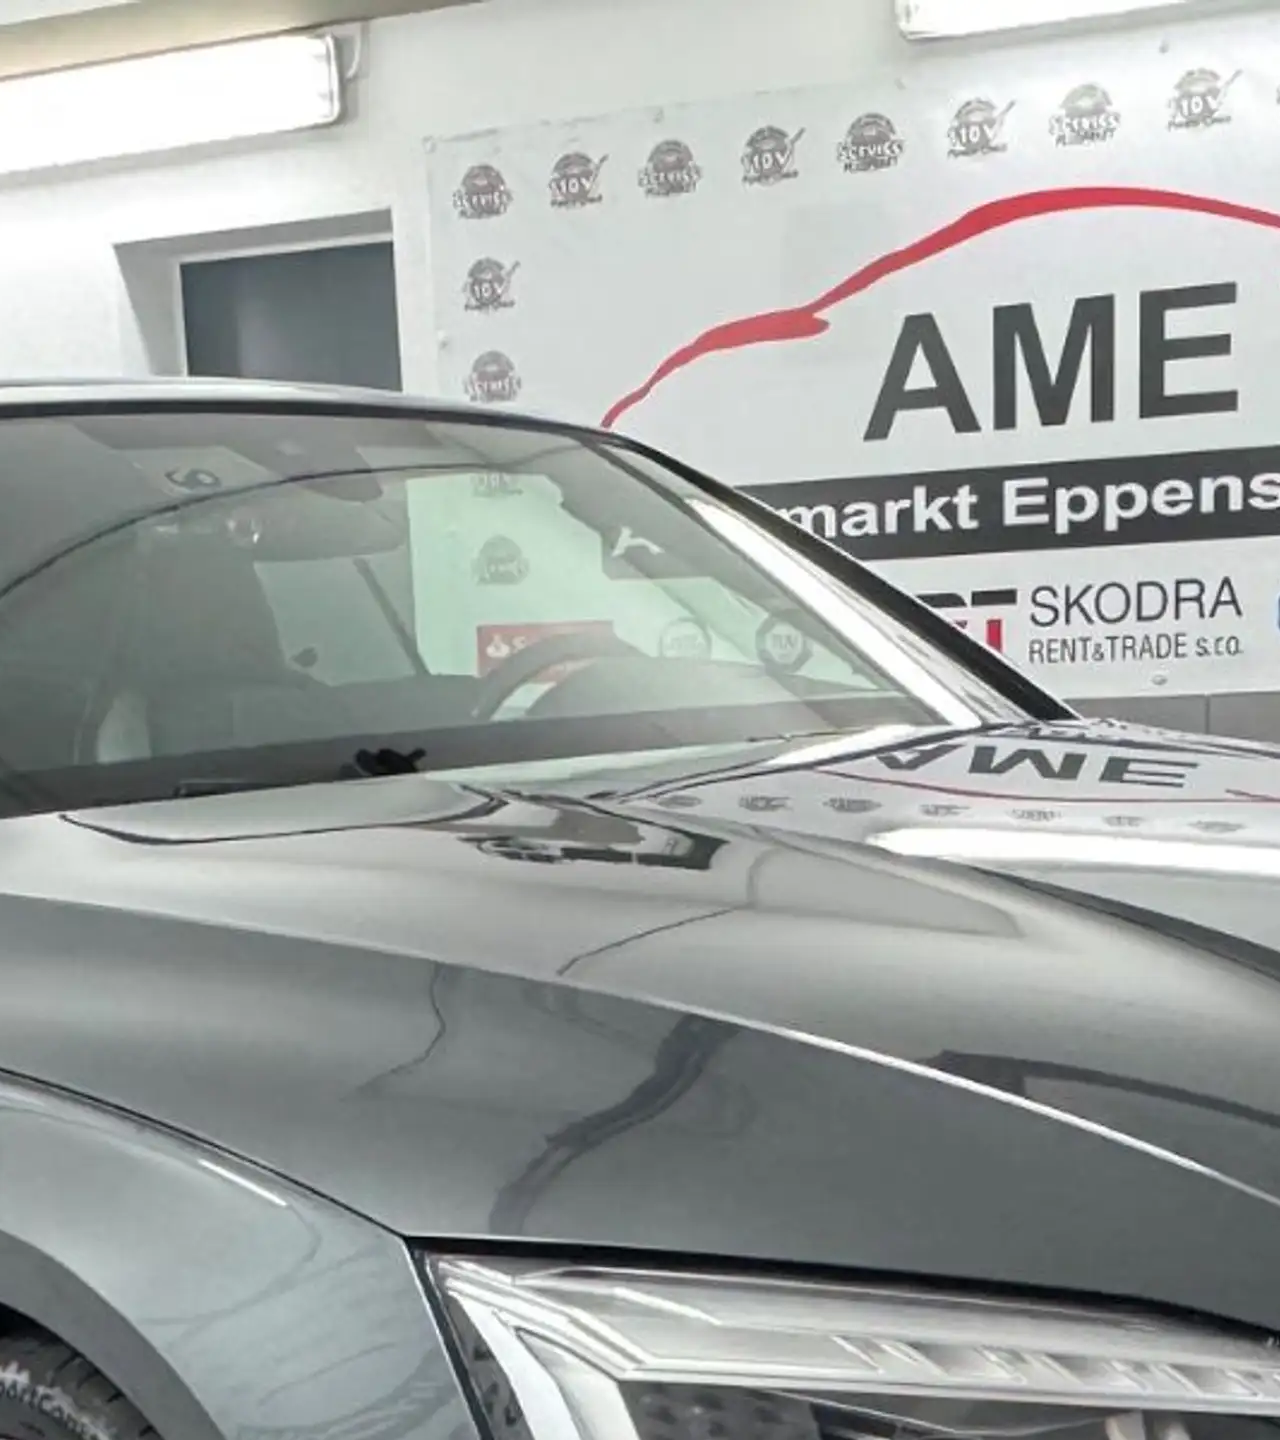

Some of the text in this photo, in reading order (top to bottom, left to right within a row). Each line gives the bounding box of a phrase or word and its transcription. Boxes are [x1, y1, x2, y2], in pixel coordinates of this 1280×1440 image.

[863, 282, 1238, 441] AME
[1028, 576, 1243, 628] SKODRA
[1028, 632, 1188, 665] RENT&TRADE
